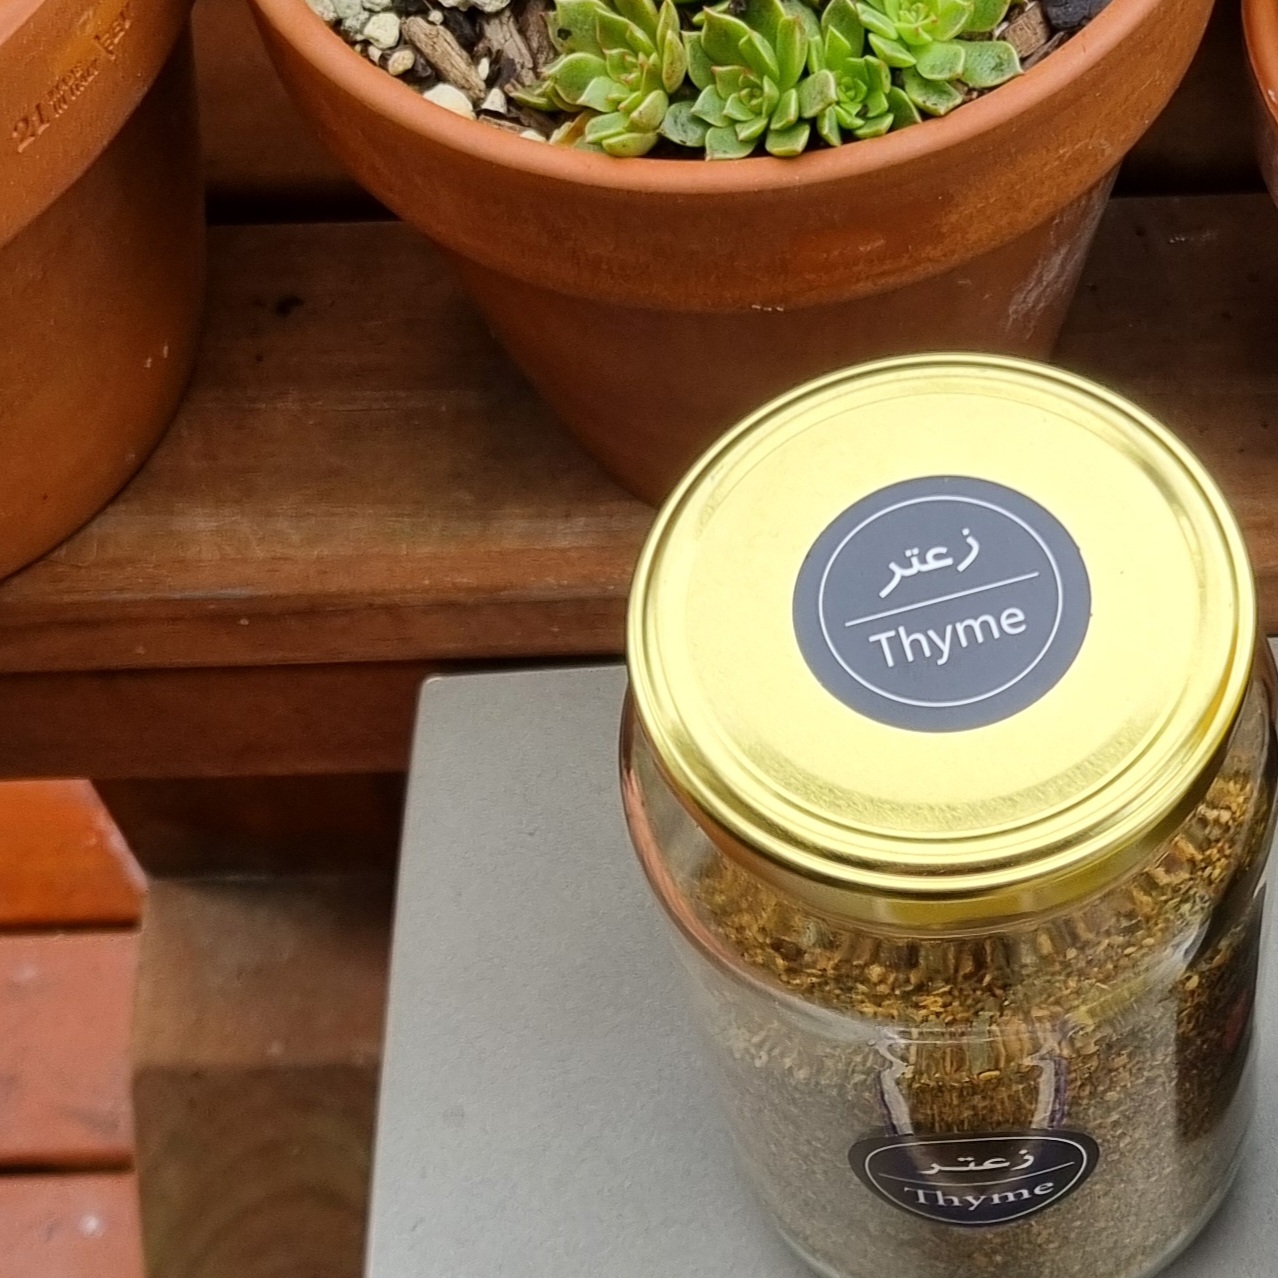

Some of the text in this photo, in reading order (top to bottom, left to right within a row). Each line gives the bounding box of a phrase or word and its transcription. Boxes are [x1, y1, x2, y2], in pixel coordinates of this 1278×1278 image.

[878, 527, 981, 599] زعتر
[868, 606, 1027, 668] Thyme
[918, 1149, 1035, 1175] زعتر
[903, 1181, 1055, 1211] Thyme
